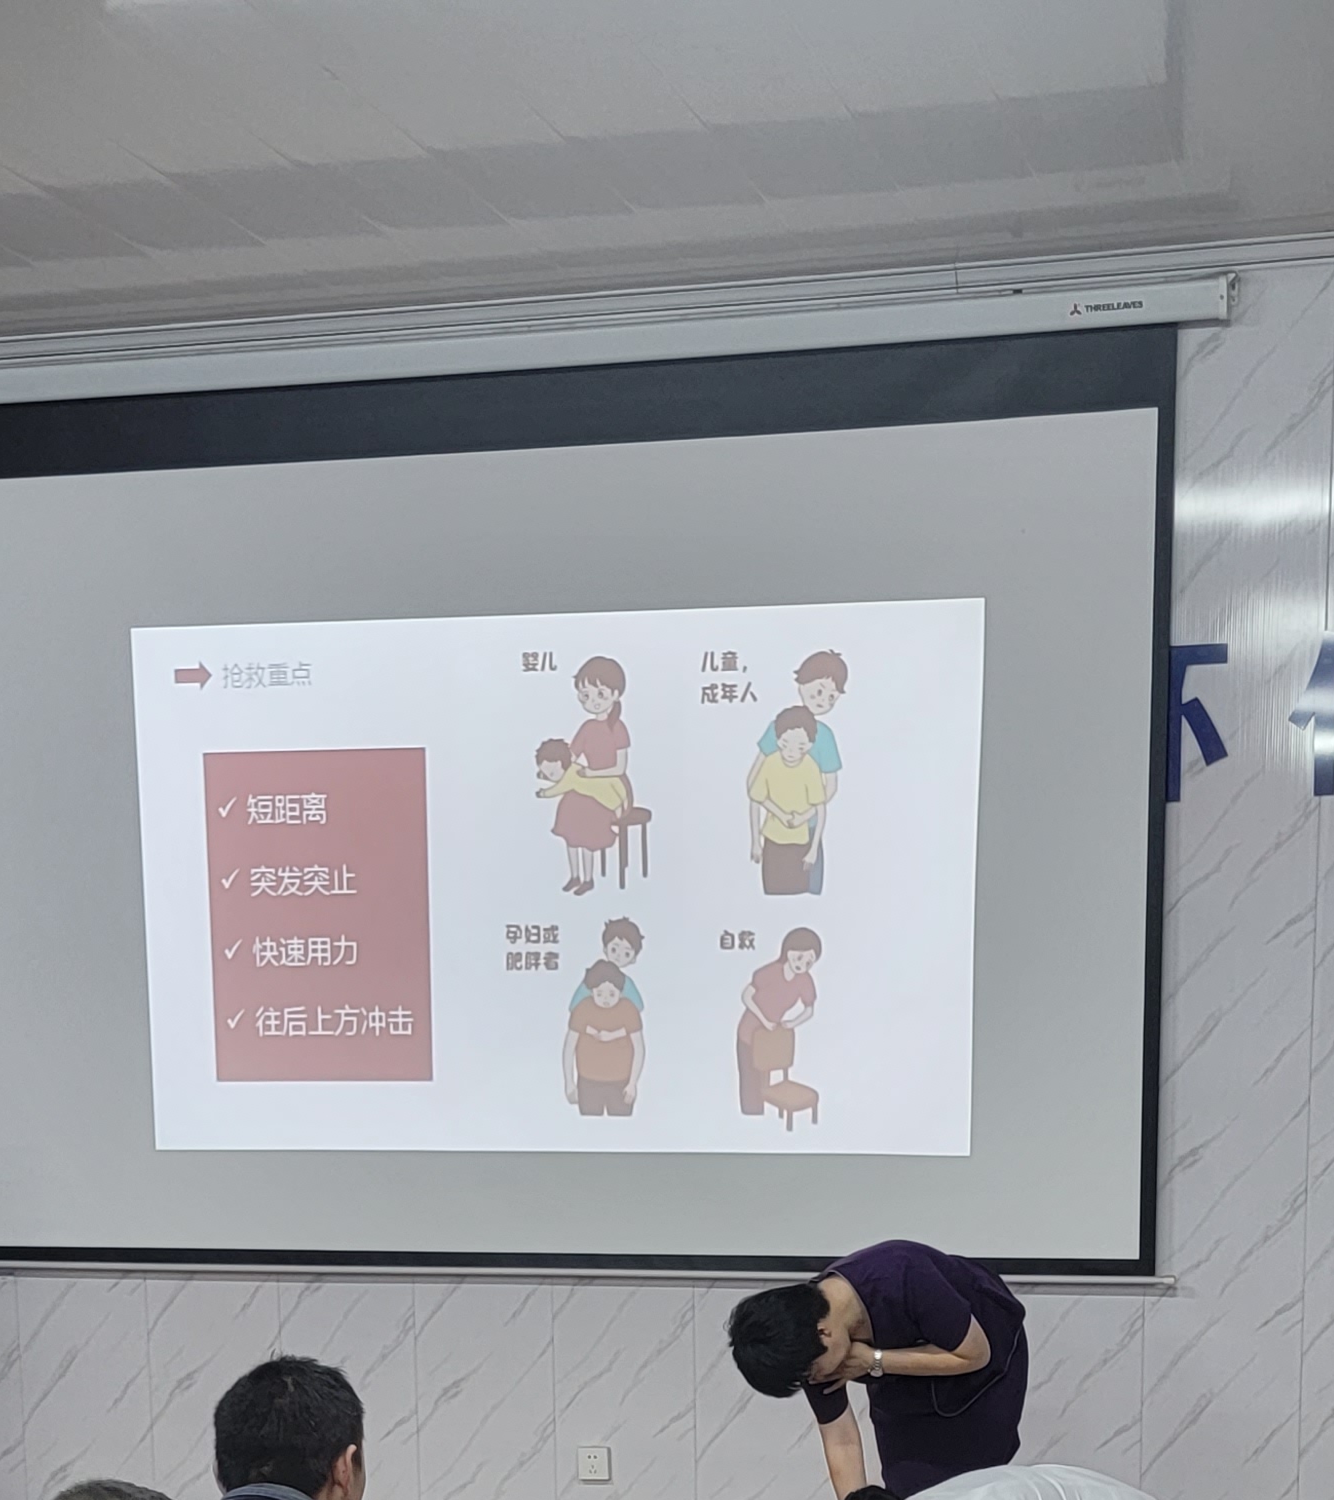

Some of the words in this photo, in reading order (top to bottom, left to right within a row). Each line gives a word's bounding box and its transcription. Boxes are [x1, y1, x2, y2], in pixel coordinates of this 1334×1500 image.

[1084, 300, 1144, 313] THREELEAVES
[521, 651, 558, 673] 婴儿
[221, 661, 313, 689] 抢救重点
[700, 681, 758, 705] 成年人
[246, 791, 328, 826] 短距离
[249, 863, 358, 898] 突发突止
[505, 923, 560, 945] 孕妇或
[719, 929, 756, 951] 自救
[251, 934, 359, 969] 快速用力
[505, 950, 560, 972] 肥胖者
[254, 1004, 415, 1038] 往后上方冲击
